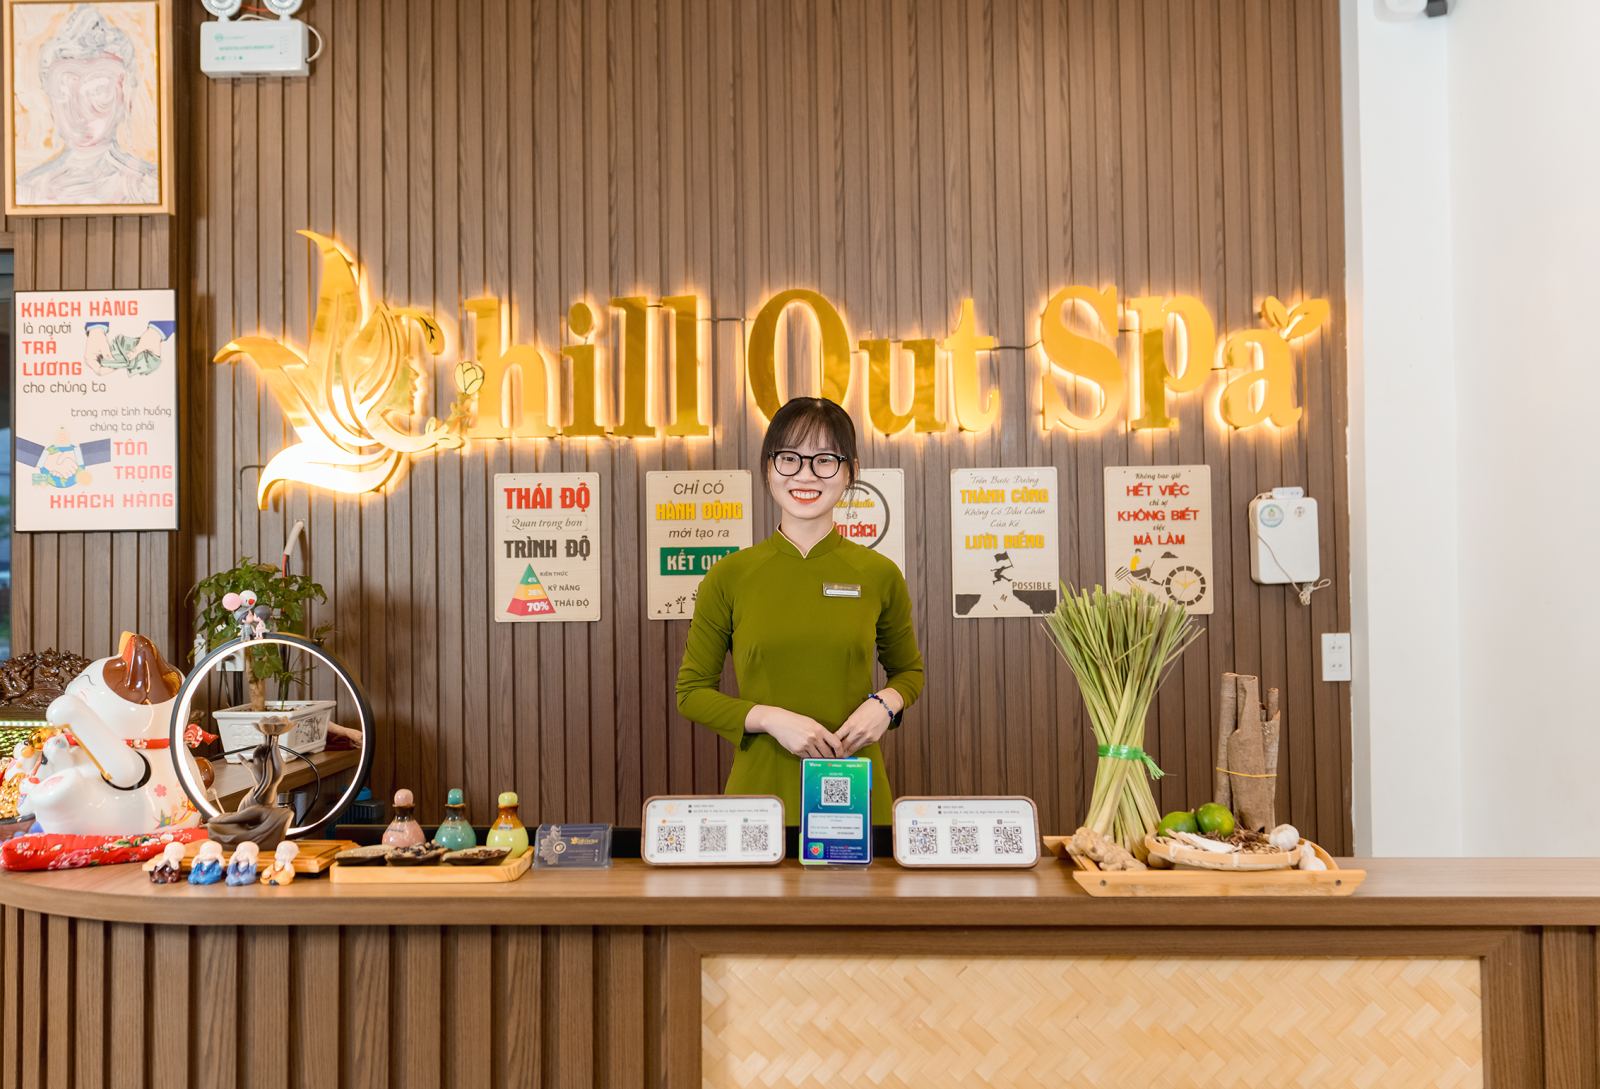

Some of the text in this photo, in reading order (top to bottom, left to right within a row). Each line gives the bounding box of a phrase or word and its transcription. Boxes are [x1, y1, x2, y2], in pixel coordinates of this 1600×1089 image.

[21, 297, 138, 318] KHÁCH HÀNG
[23, 321, 72, 337] là người
[21, 337, 57, 355] TRẢ
[747, 288, 1000, 434] Out
[1041, 285, 1302, 431] Spa
[22, 361, 82, 376] LƯƠNG
[22, 381, 107, 395] cho chúng ta
[70, 405, 172, 419] trong mọi tình huống
[89, 420, 155, 433] chúng ta phải
[113, 438, 148, 456] TÔN
[113, 465, 173, 483] TRỌNG
[1135, 473, 1156, 481] Không
[673, 479, 725, 495] CHỈ CÓ
[959, 485, 1049, 504] THÀNH CÔNG
[1126, 482, 1190, 498] HẾT VIỆC
[50, 490, 173, 509] KHÁCH HÀNG
[503, 482, 591, 513] THÁI ĐỘ
[850, 498, 875, 509] Muốn
[656, 498, 743, 523] HÀNH ĐỘNG
[846, 511, 858, 520] sẽ
[964, 507, 989, 520] Không
[990, 507, 1002, 516] Có
[1024, 506, 1046, 515] Chân
[1117, 507, 1200, 521] KHÔNG BIẾT
[511, 517, 583, 531] Quan trọng hơn
[849, 520, 877, 538] CÁCH
[1152, 524, 1166, 532] việc
[668, 527, 730, 540] mới tạo ra
[965, 529, 1045, 549] LƯỜI BIẾNG
[1133, 531, 1186, 545] MÀ LÀM
[503, 535, 591, 561] TRÌNH ĐỘ
[666, 548, 695, 571] KẾT
[547, 583, 581, 591] KỸ NĂNG
[1012, 581, 1052, 590] POSSIBLE
[526, 601, 550, 613] 70%
[554, 597, 590, 609] THÁI ĐỘ
